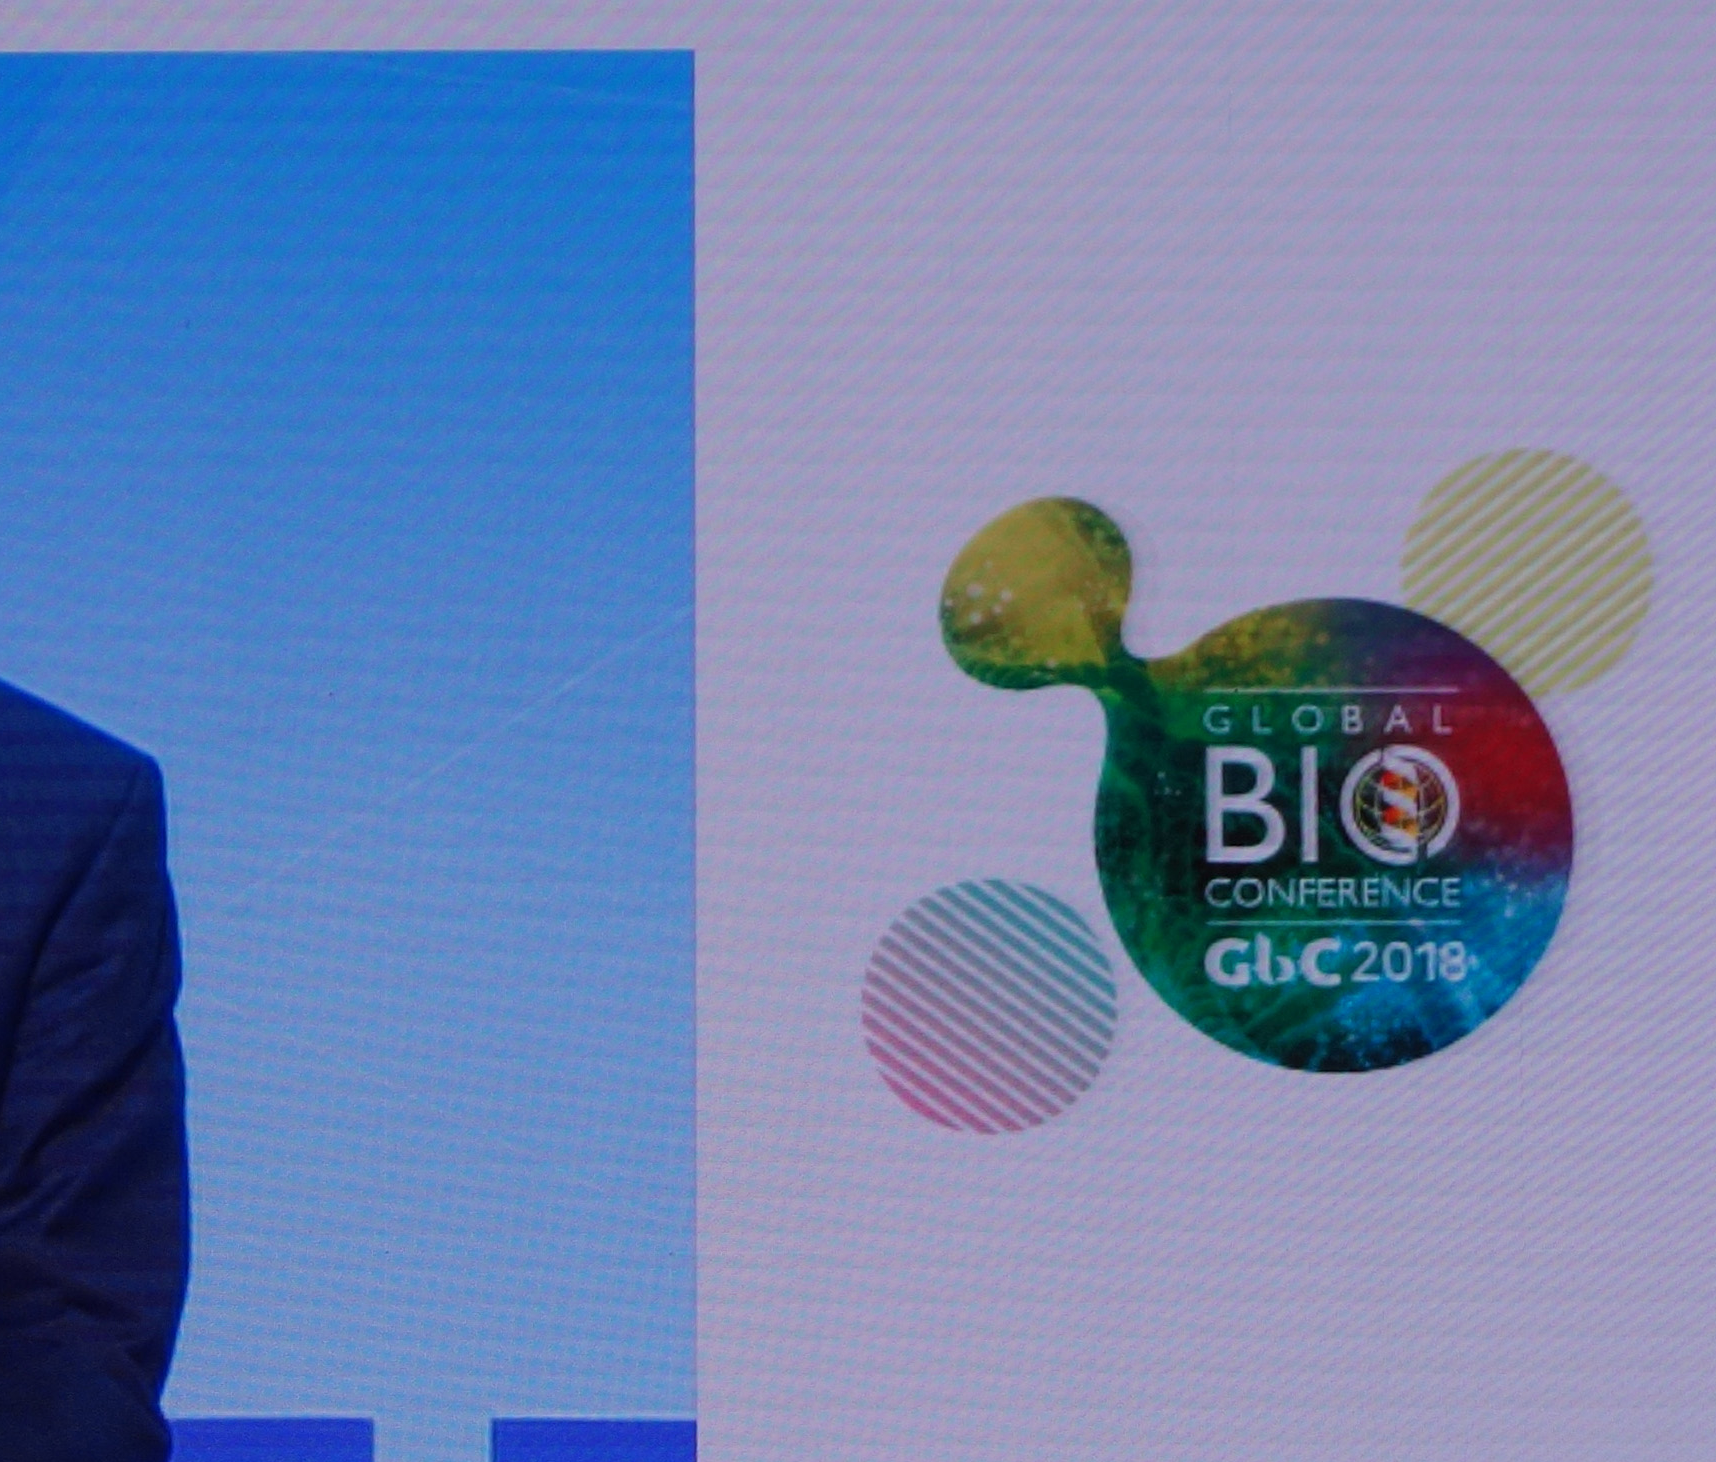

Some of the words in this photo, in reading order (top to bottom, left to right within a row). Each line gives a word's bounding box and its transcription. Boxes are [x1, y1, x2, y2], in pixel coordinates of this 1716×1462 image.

[1203, 704, 1453, 735] GLOBAL
[1205, 743, 1461, 867] BIO
[1203, 876, 1462, 909] CONFERENCE
[1350, 940, 1468, 983] 2018
